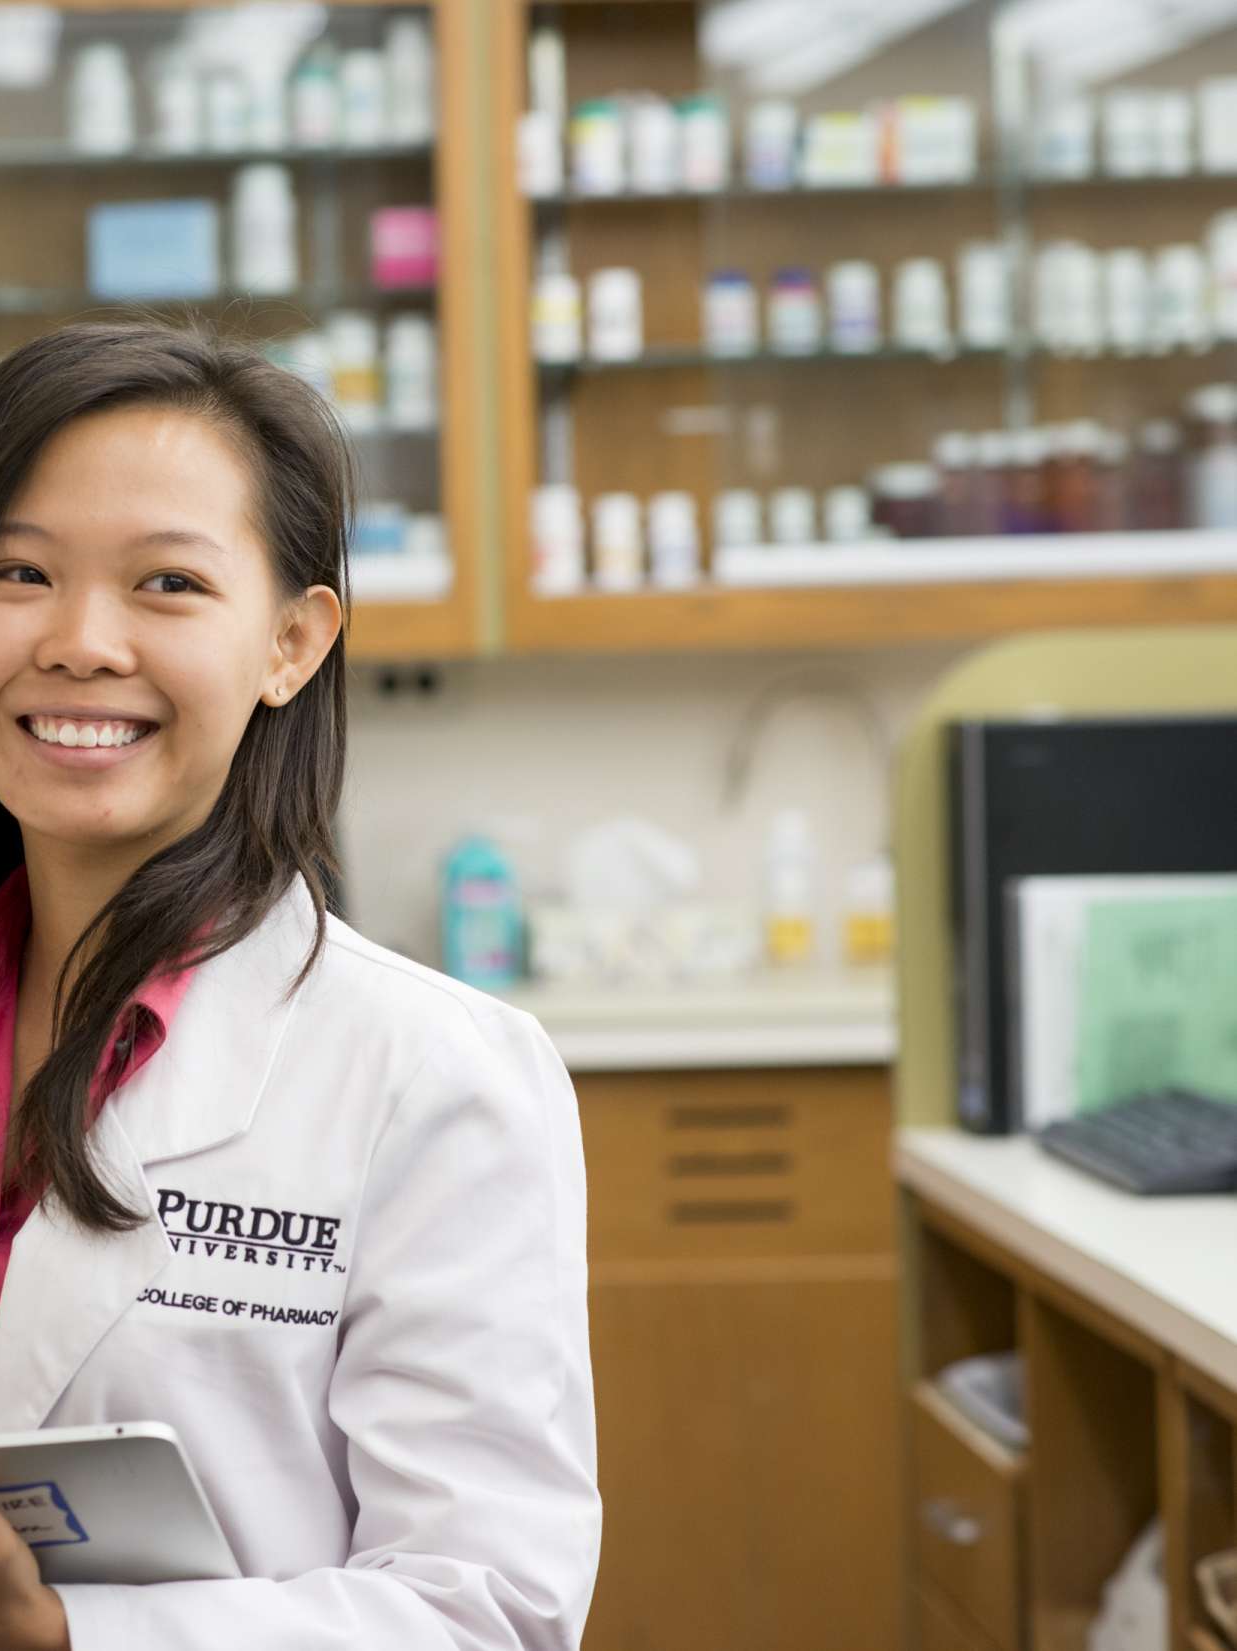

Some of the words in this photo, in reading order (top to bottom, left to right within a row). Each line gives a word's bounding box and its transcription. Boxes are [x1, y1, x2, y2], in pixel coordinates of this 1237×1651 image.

[157, 1188, 341, 1250] PURDUE
[168, 1238, 333, 1273] NIVERSITY
[222, 1299, 247, 1316] OF
[250, 1304, 339, 1326] PHARMACY
